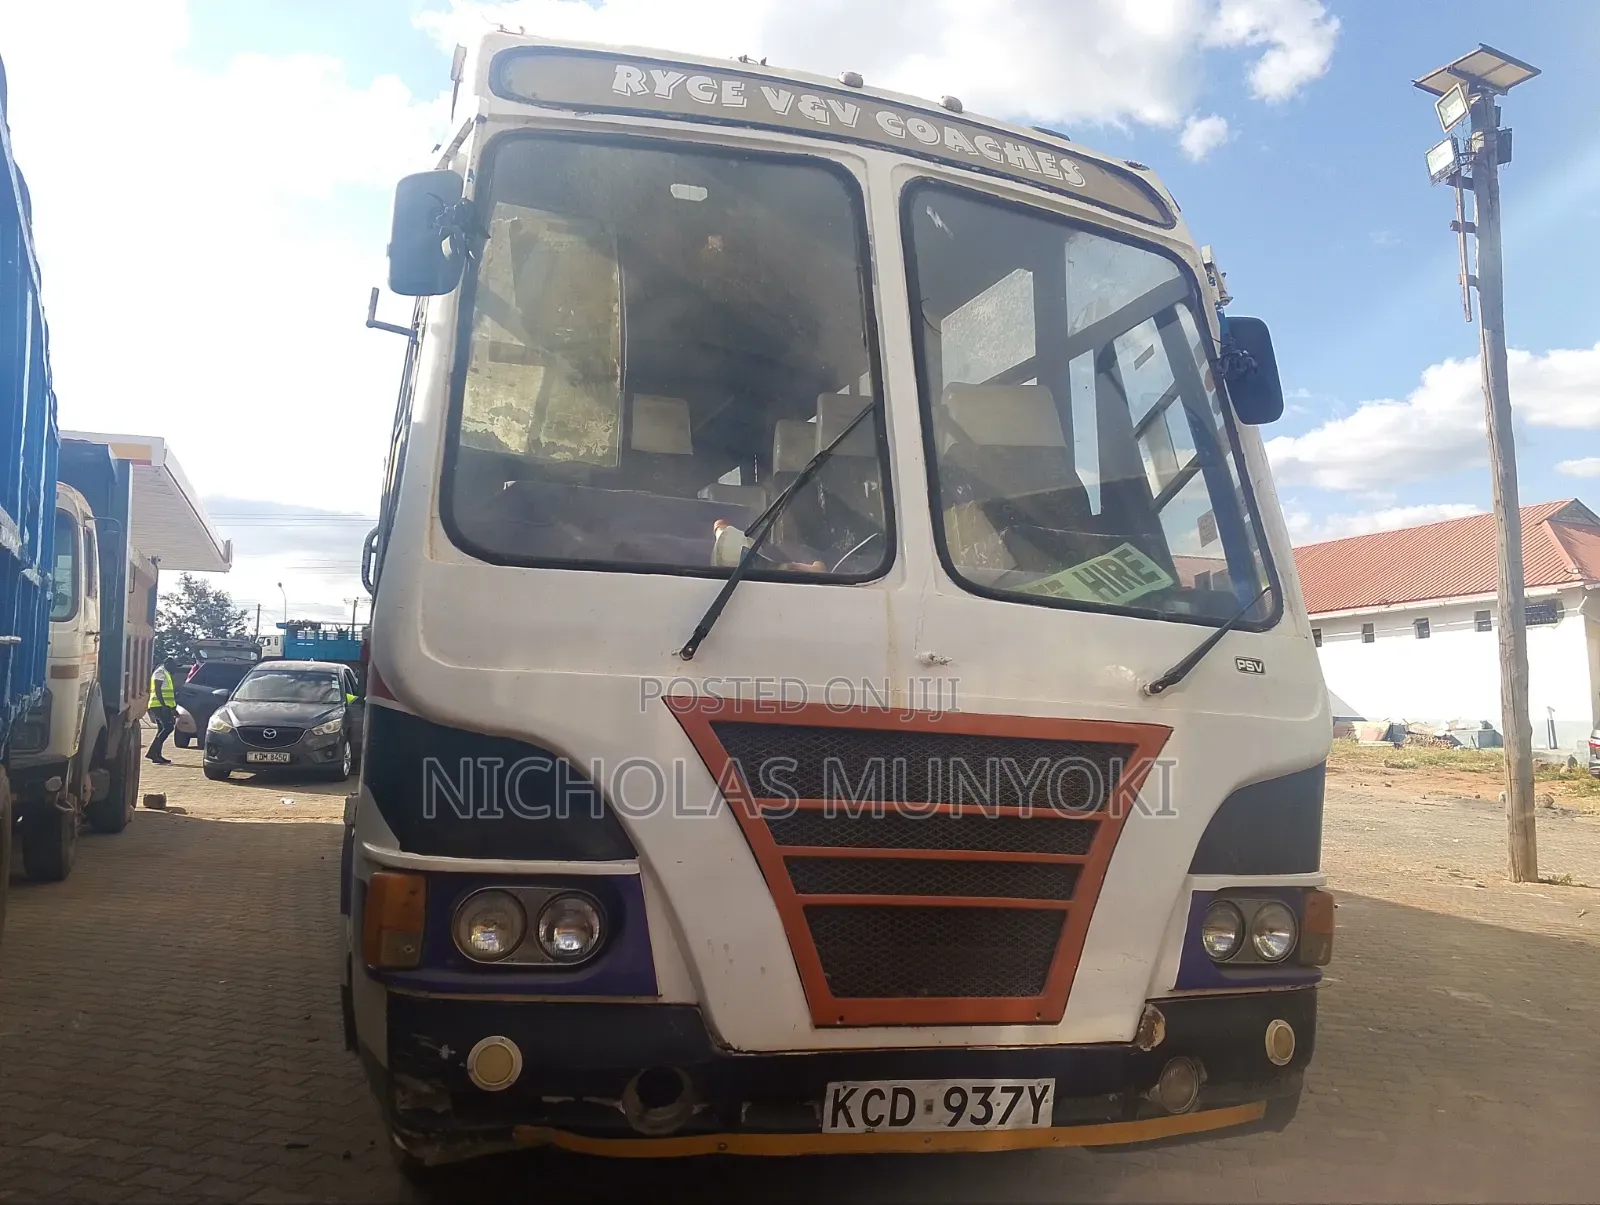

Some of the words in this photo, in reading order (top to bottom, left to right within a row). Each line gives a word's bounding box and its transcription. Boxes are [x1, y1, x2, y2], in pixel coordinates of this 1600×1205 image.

[612, 64, 747, 108] RYCE
[760, 86, 860, 128] V&V
[875, 111, 1086, 188] COACHES
[1072, 548, 1162, 602] HIRE
[1236, 659, 1263, 673] PSV
[830, 1086, 916, 1129] KCD
[943, 1084, 1051, 1127] 937Y
